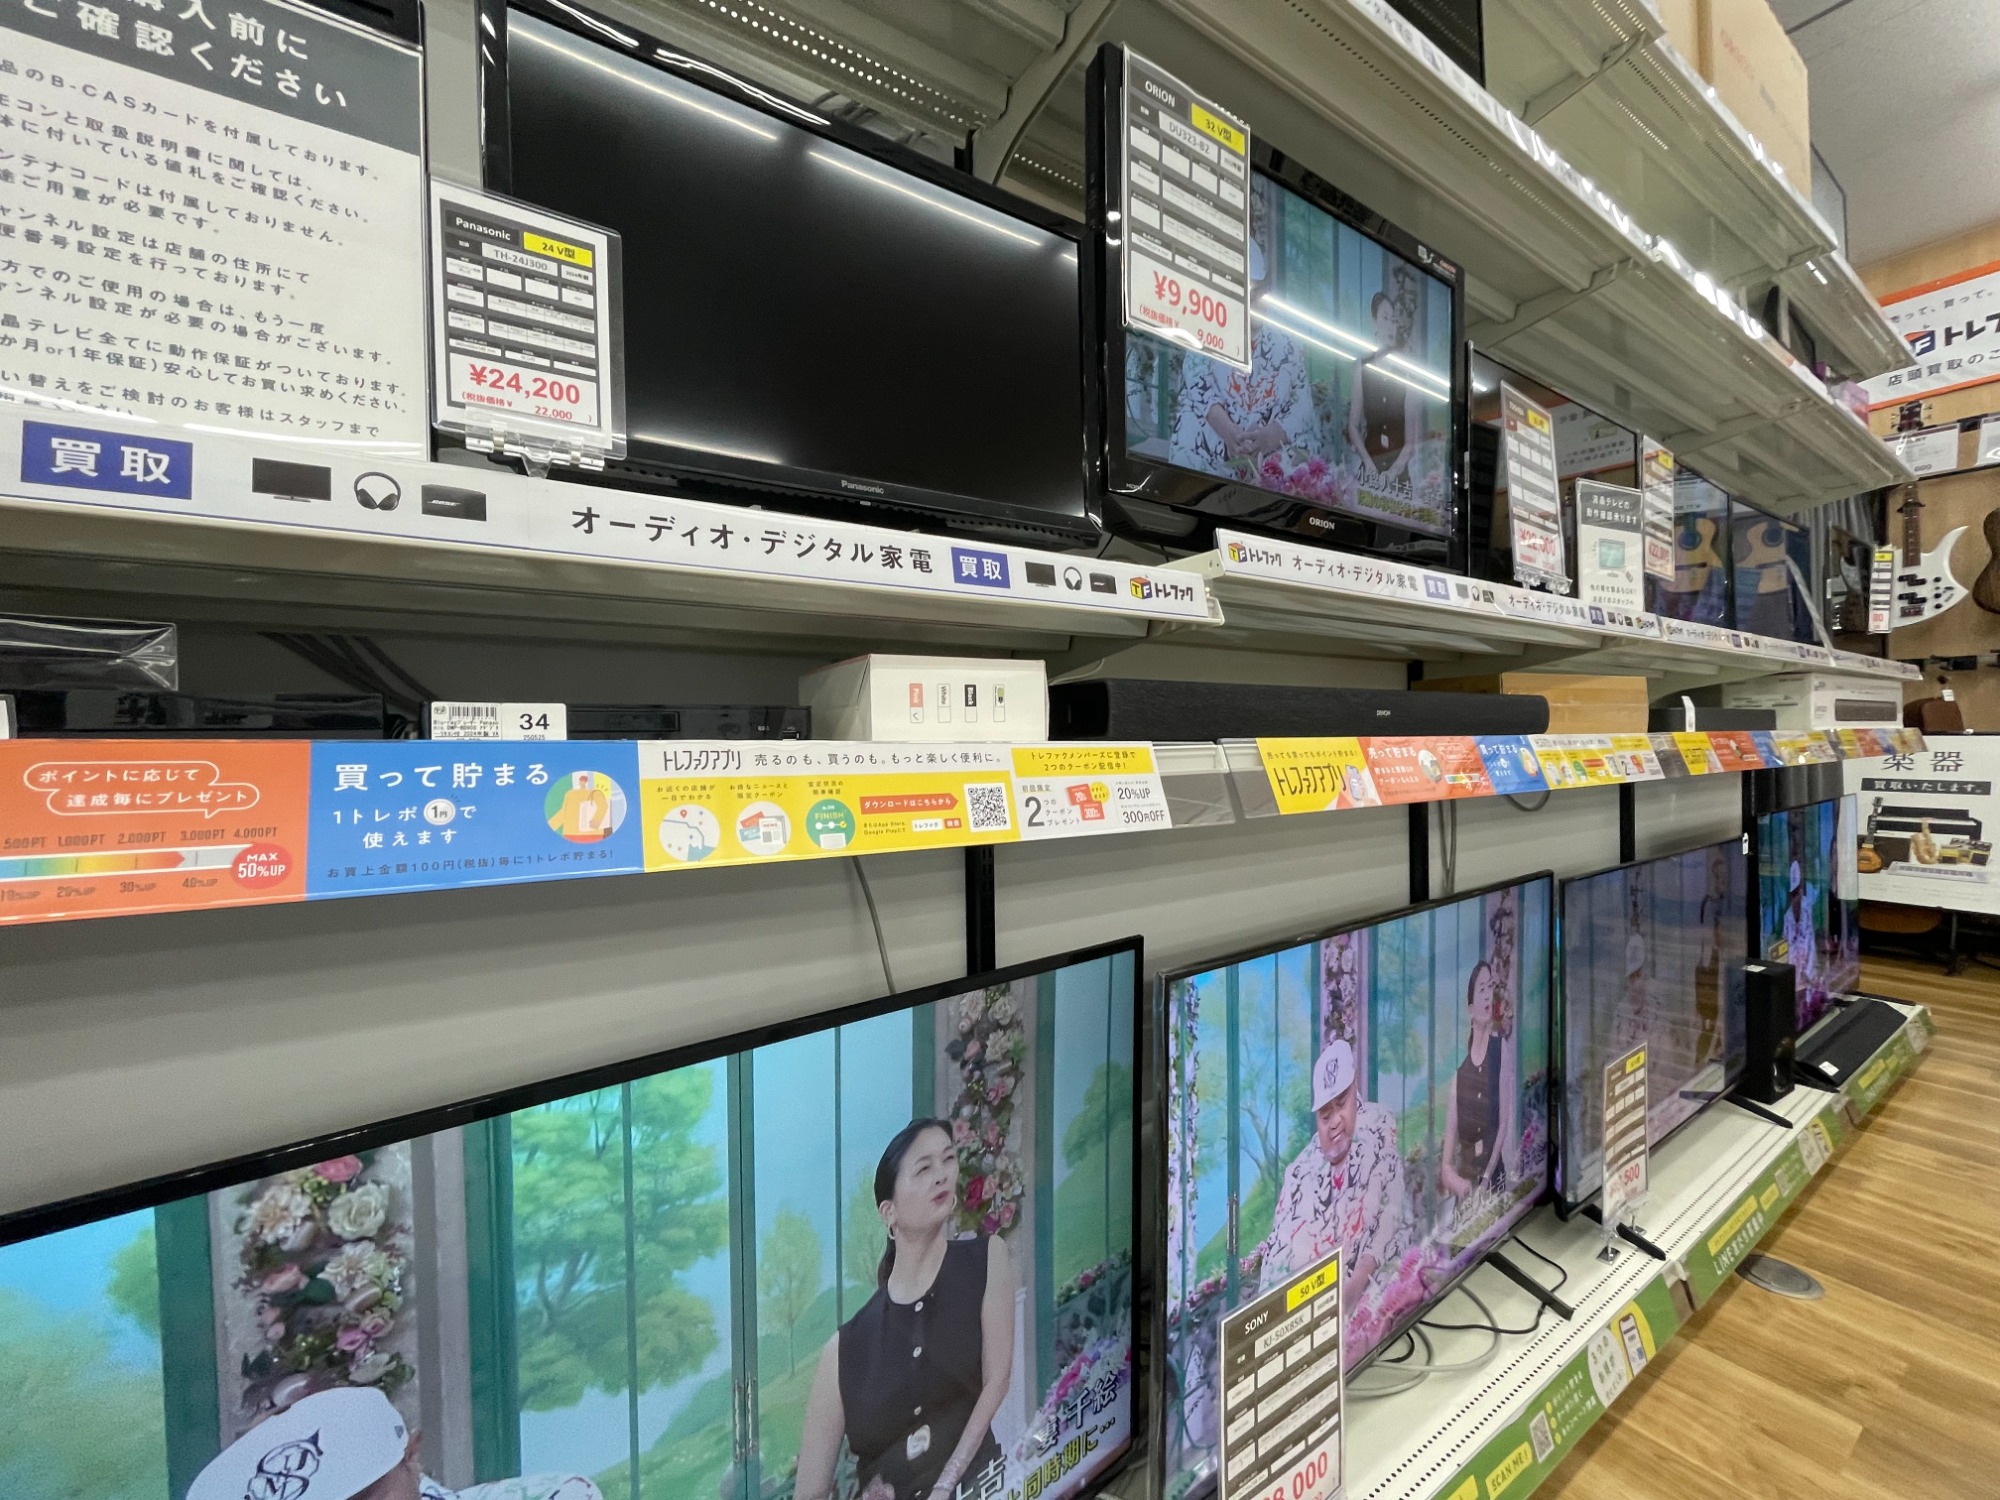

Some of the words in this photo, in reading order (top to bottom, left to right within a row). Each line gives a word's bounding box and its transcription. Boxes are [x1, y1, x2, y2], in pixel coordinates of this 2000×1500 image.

[128, 0, 309, 61] 入前に
[1145, 80, 1176, 108] ORION
[1205, 119, 1216, 133] 32
[456, 217, 512, 241] Panasonic
[542, 242, 555, 253] 24
[493, 248, 548, 272] TH-24J300
[1153, 270, 1228, 329] ¥9,900
[469, 363, 580, 405] ¥24,200
[841, 479, 884, 495] Panasonic
[51, 437, 171, 485] 買取
[571, 506, 933, 574] オーディオ・デジタル家電
[959, 556, 1003, 580] 買取
[1309, 516, 1336, 531] ORION
[519, 713, 550, 730] 34
[663, 749, 742, 772] トレファクアプリ
[754, 752, 1003, 766] 売るのも、買うのも。もっと楽しく便利に。
[39, 768, 201, 784] ポイントに応じて
[333, 763, 549, 793] 買って貯まる
[1273, 764, 1347, 797] トレファクアプリ
[1117, 787, 1151, 800] 20%UP
[1874, 781, 1983, 794] 買取いたします。
[66, 791, 248, 808] 達成毎にプレゼント
[864, 797, 952, 810] ダウンロードはこちらから
[814, 812, 846, 821] FINISH
[1024, 796, 1046, 828] 2
[1122, 810, 1165, 824] 300円OFF
[363, 828, 458, 849] 使えます
[246, 852, 279, 862] MAX
[237, 862, 286, 878] 50%UP
[1300, 1286, 1310, 1299] 50
[1244, 1310, 1269, 1335] SONY
[1491, 1463, 1512, 1492] SCAN
